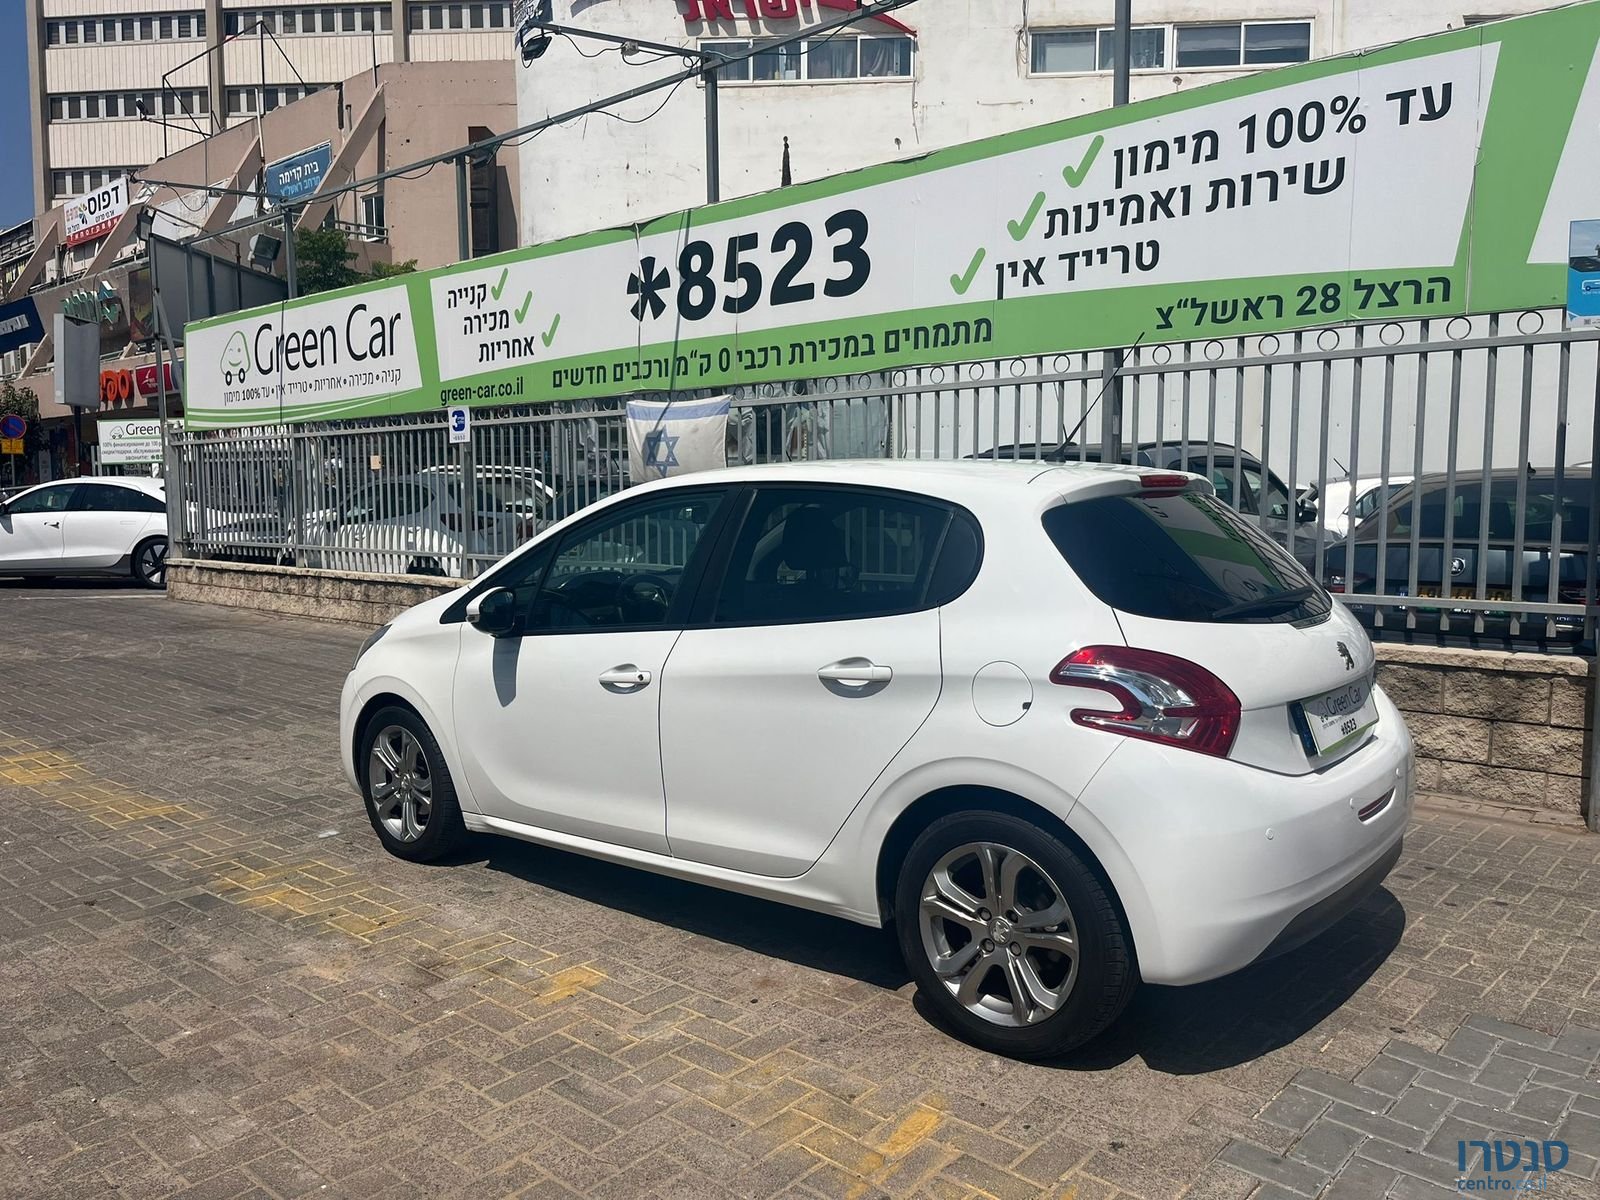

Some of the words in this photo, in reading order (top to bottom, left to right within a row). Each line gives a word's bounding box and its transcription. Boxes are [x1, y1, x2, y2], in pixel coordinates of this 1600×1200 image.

[1384, 81, 1454, 126] עד
[1238, 95, 1368, 154] 100%
[1113, 129, 1219, 189] מימון
[1205, 156, 1346, 214] שירות
[88, 186, 119, 215] דפוס
[1043, 183, 1191, 240] ואמינות
[1058, 238, 1160, 282] טרייד
[995, 254, 1045, 301] אין
[448, 283, 487, 309] קנייה
[1296, 282, 1341, 317] 28
[1352, 273, 1452, 312] הרצל
[464, 309, 510, 335] מכירה
[884, 316, 993, 353] מתמחים
[254, 321, 337, 376] Green
[346, 303, 402, 361] Car
[479, 336, 535, 363] אחריות
[789, 333, 876, 365] במכירת
[613, 358, 668, 382] ורכבים
[718, 346, 731, 373] 0
[736, 343, 782, 371] רכבי
[287, 381, 307, 394] טרייד
[314, 376, 342, 392] אחריות
[349, 371, 374, 387] מכירה
[381, 368, 401, 386] קניה
[552, 364, 607, 389] חדשים
[223, 390, 241, 406] מימון
[242, 388, 261, 401] 100%
[261, 386, 270, 399] עד
[440, 376, 524, 406] green-car.co.il
[125, 423, 161, 436] Green
[1326, 694, 1349, 715] Green
[1348, 686, 1362, 704] Car
